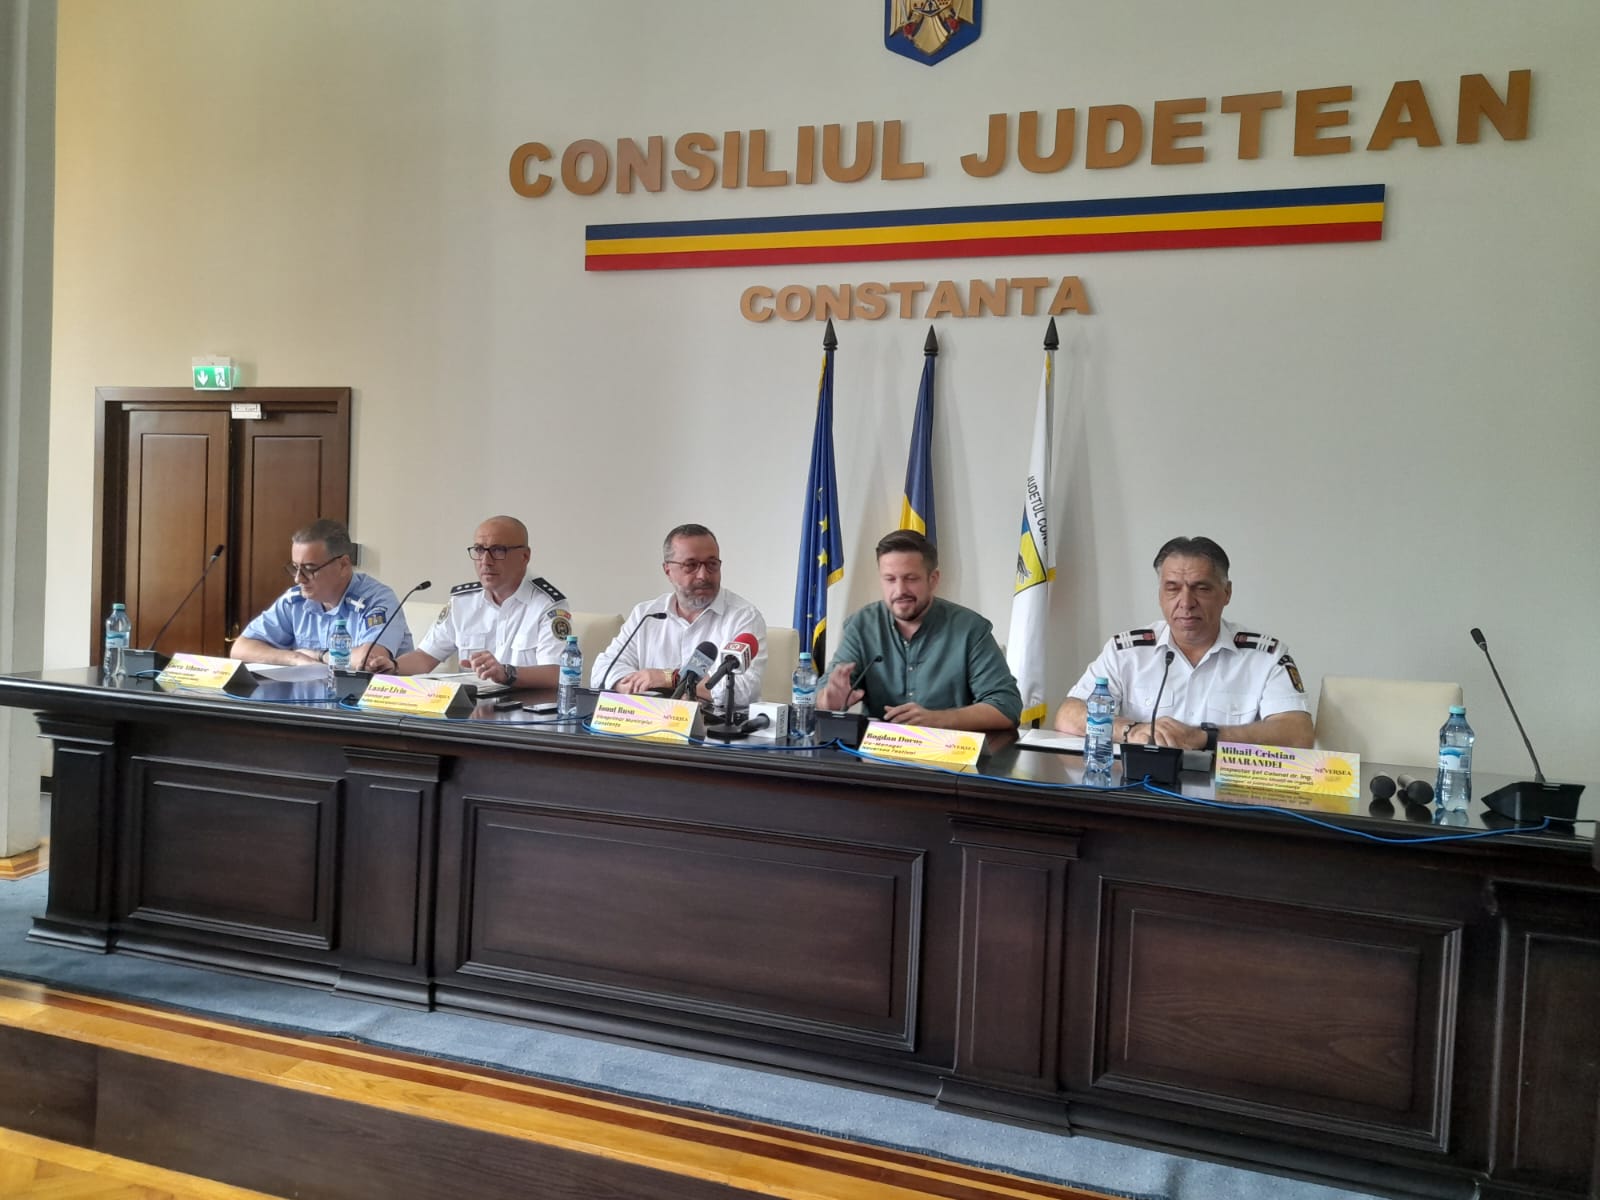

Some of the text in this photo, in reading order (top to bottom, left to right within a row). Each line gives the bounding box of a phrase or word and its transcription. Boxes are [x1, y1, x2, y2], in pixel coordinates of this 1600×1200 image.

[509, 69, 1532, 198] CONSILIUL JUDETEAN
[740, 275, 1093, 322] CONSTANTA
[866, 733, 897, 742] Bogdan
[1221, 756, 1283, 769] AMARANDEI
